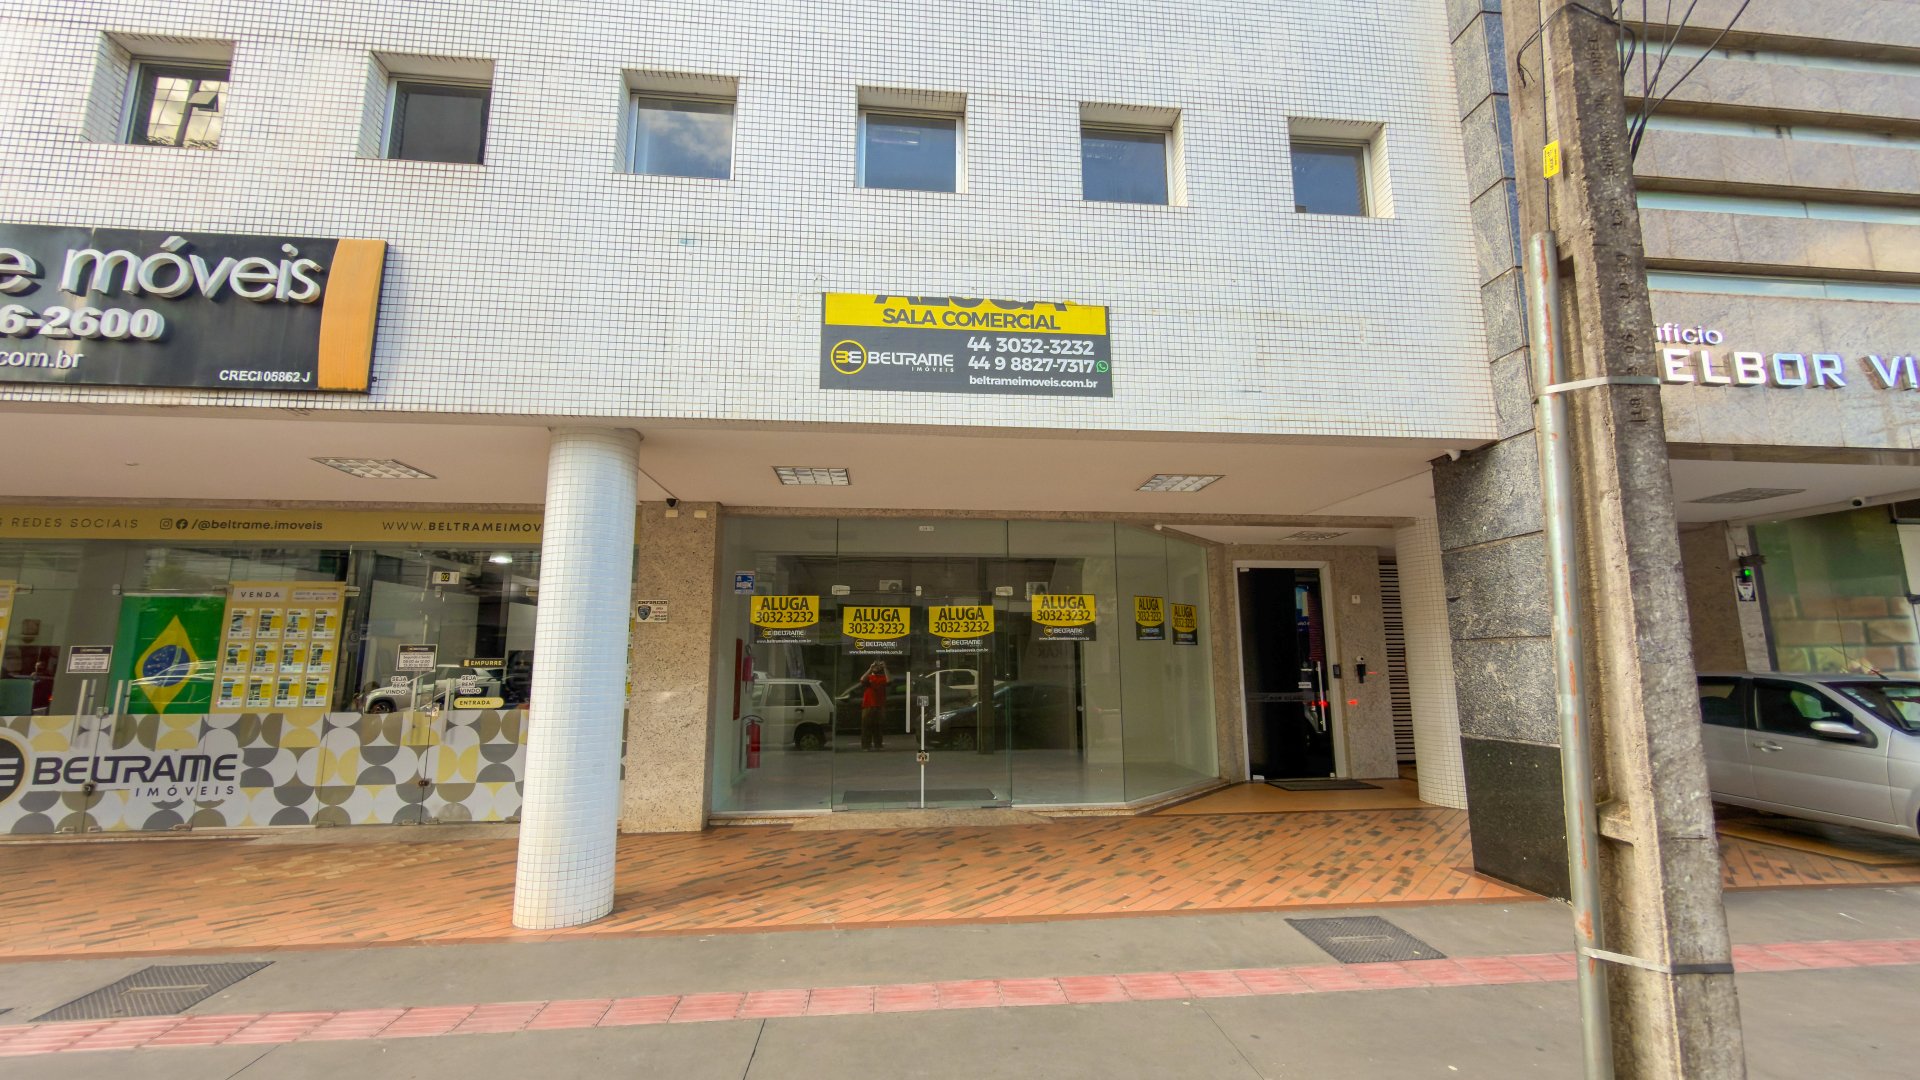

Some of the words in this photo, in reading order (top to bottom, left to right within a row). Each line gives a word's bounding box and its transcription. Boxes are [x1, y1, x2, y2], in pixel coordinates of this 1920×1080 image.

[59, 235, 324, 302] móveis
[882, 308, 937, 326] SALA
[941, 310, 1061, 331] COMERCIAL
[967, 336, 992, 352] 44
[996, 337, 1095, 356] 3032-3232
[867, 351, 954, 367] BELTRAME
[967, 355, 991, 371] 44
[994, 356, 1004, 371] 9
[1010, 357, 1095, 373] 8827-7317
[1661, 348, 1847, 388] ELBOR
[219, 369, 263, 383] CRECI
[263, 370, 300, 383] 05862
[301, 371, 311, 383] J
[969, 375, 1098, 389] beltrameimoveis.com.br
[11, 517, 62, 528] REDES
[70, 518, 138, 529] SOCIAIS
[382, 521, 542, 532] WWW.BELTRAMEIMOV
[760, 597, 809, 610] ALUGA
[1041, 596, 1086, 609] ALUGA
[1138, 598, 1159, 611] ALUGA
[853, 608, 901, 622] ALUGA
[938, 607, 985, 621] ALUGA
[1174, 606, 1193, 618] ALUGA
[32, 753, 238, 785] BELTRAME
[135, 783, 235, 797] IMÓVEIS
